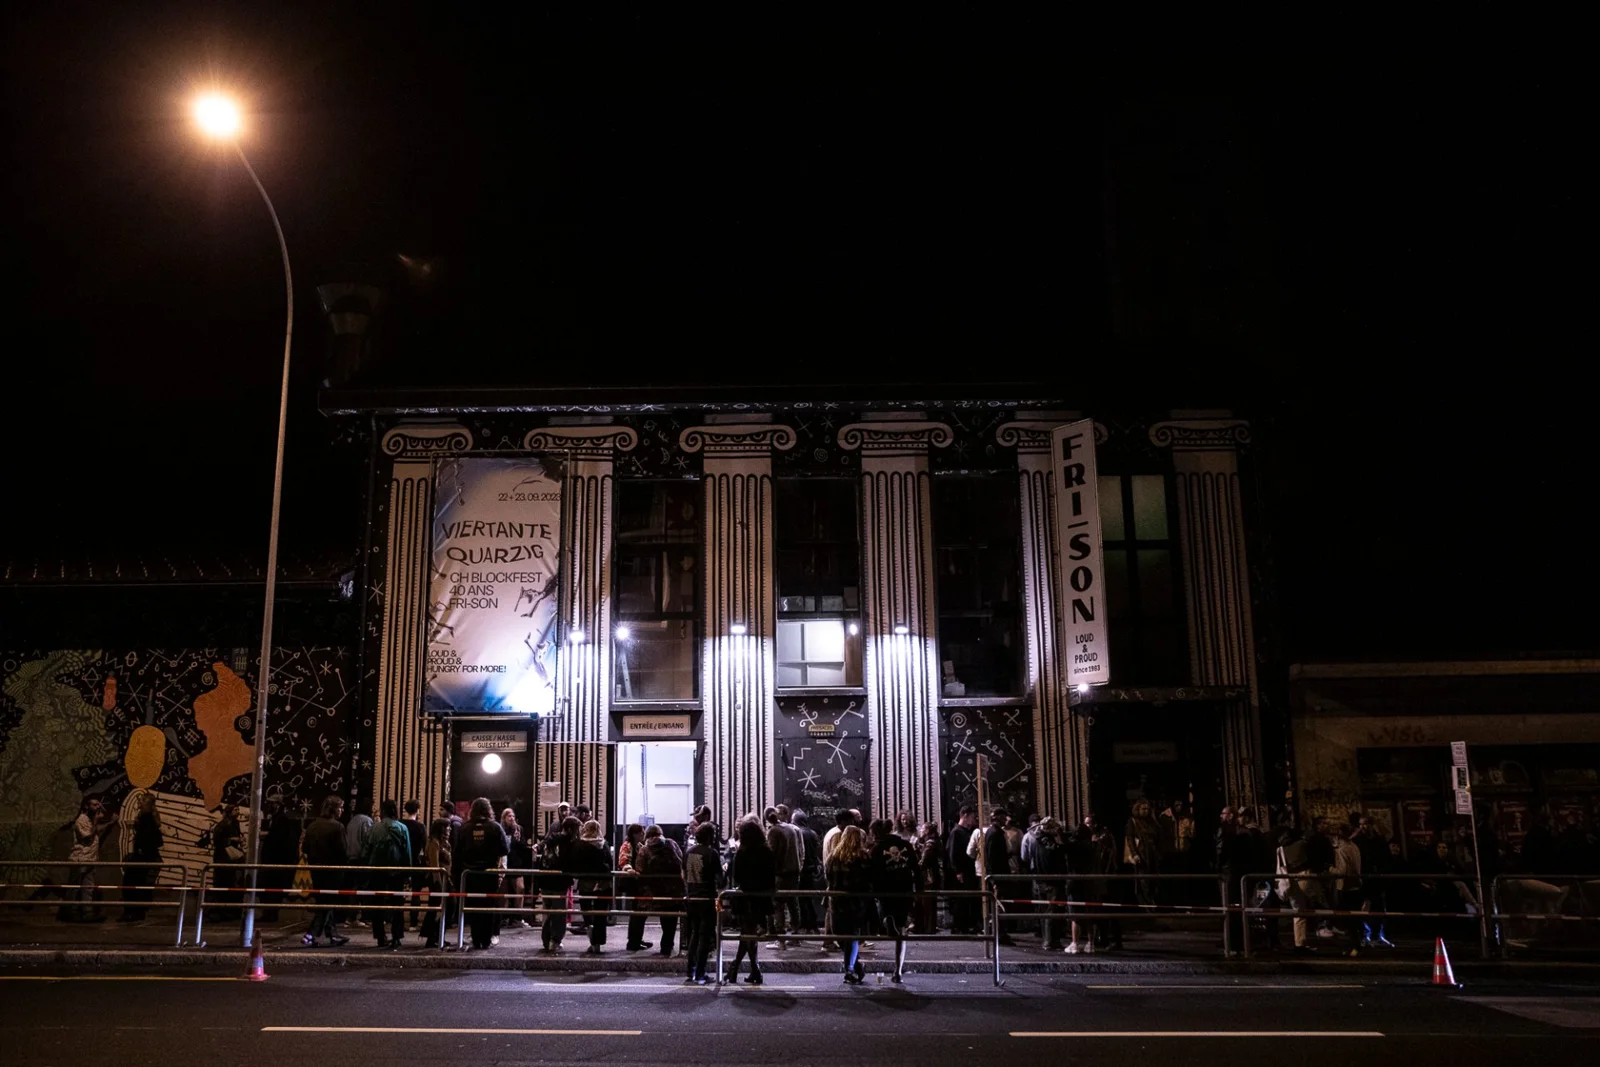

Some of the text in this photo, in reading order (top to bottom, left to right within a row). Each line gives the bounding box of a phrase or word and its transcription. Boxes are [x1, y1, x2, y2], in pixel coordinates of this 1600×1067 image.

[441, 520, 553, 540] VIERTANTE
[446, 544, 544, 566] QUARZIG
[450, 572, 543, 583] CH BLOCKFEST
[449, 585, 494, 596] 40 ANS
[449, 598, 498, 609] FRI-SON
[1075, 633, 1094, 644] LOUD
[1082, 644, 1088, 653] &
[1074, 652, 1098, 664] PROUD
[426, 665, 507, 673] HUNGRY FOR MORE!
